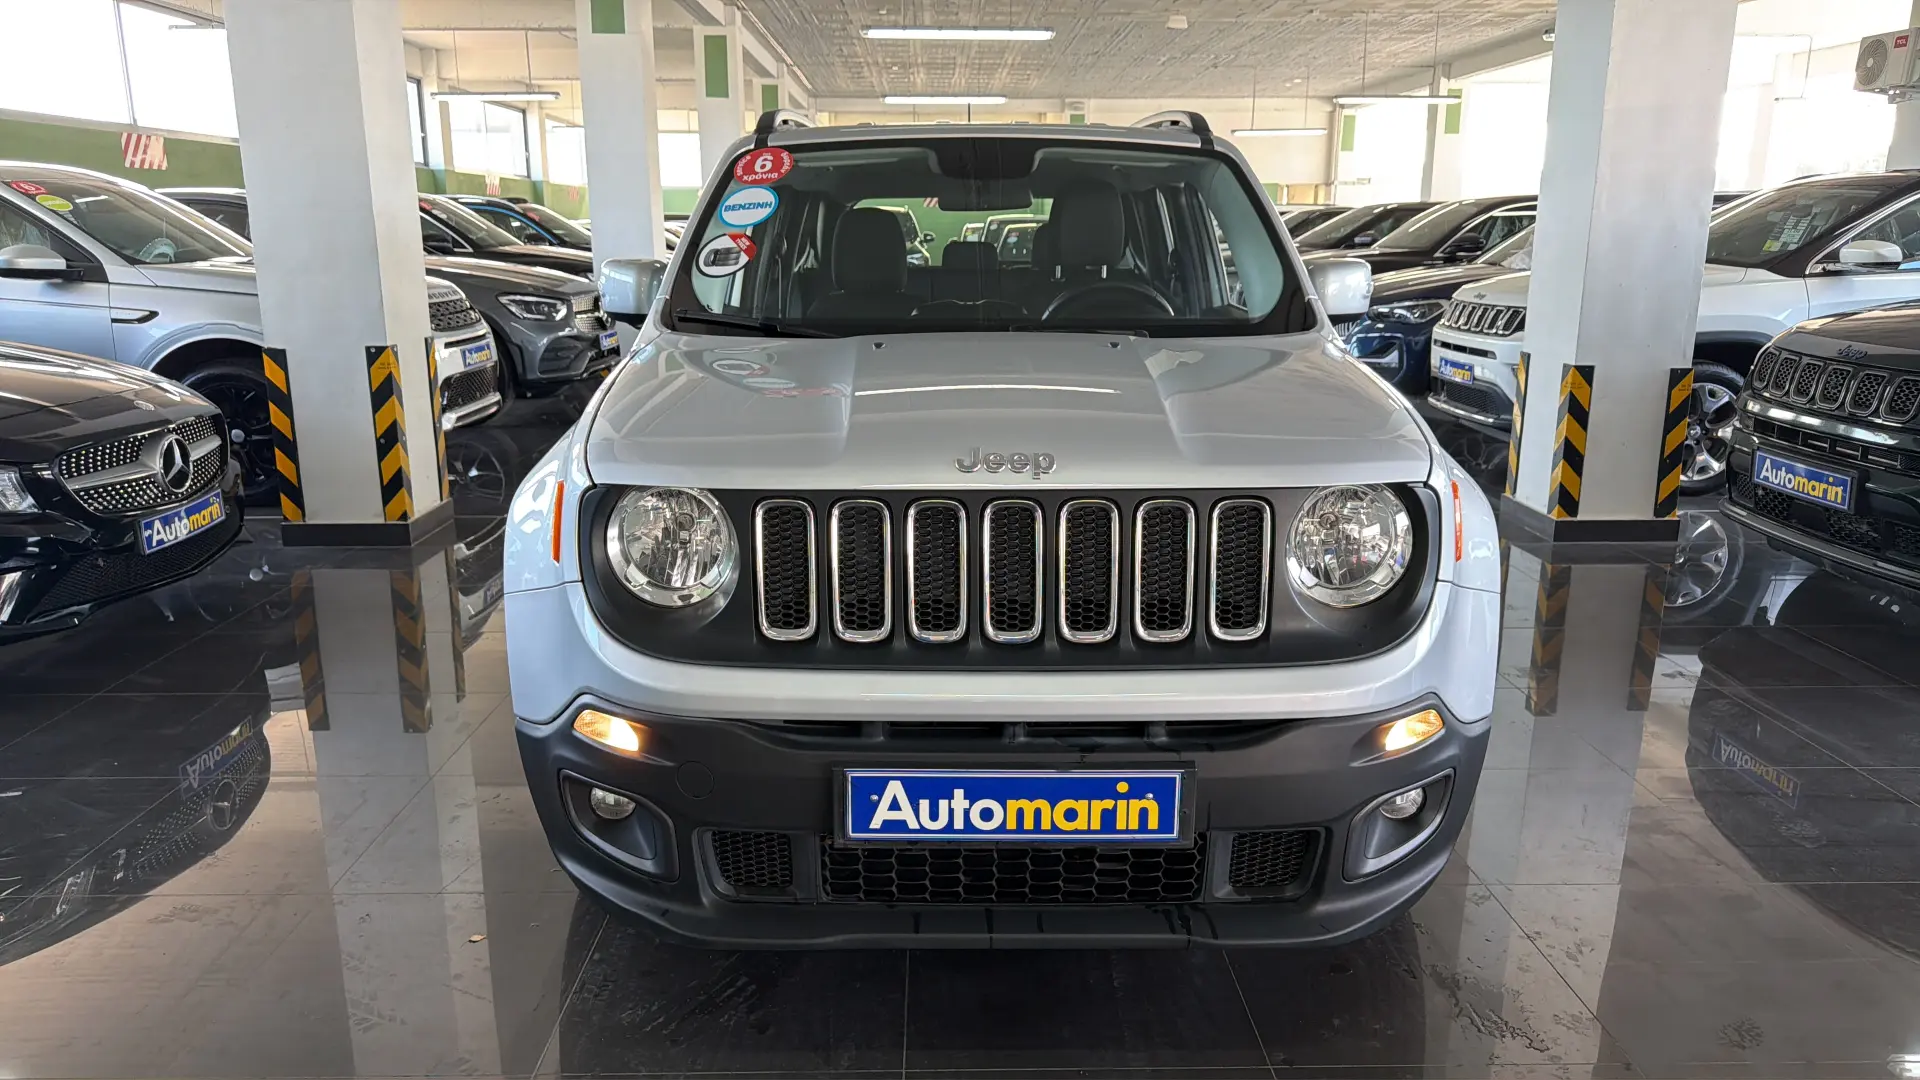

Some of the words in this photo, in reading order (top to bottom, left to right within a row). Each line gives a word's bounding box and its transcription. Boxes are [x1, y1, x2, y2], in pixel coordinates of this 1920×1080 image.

[737, 155, 751, 176] service
[742, 173, 778, 182] χρόνια
[754, 155, 774, 173] 6
[723, 201, 773, 212] ΒΕΝΖΙΝΗ
[953, 446, 1056, 480] Jeep
[1759, 458, 1843, 503] Automarin
[151, 496, 222, 547] Automarin
[869, 779, 1159, 831] Automarin
